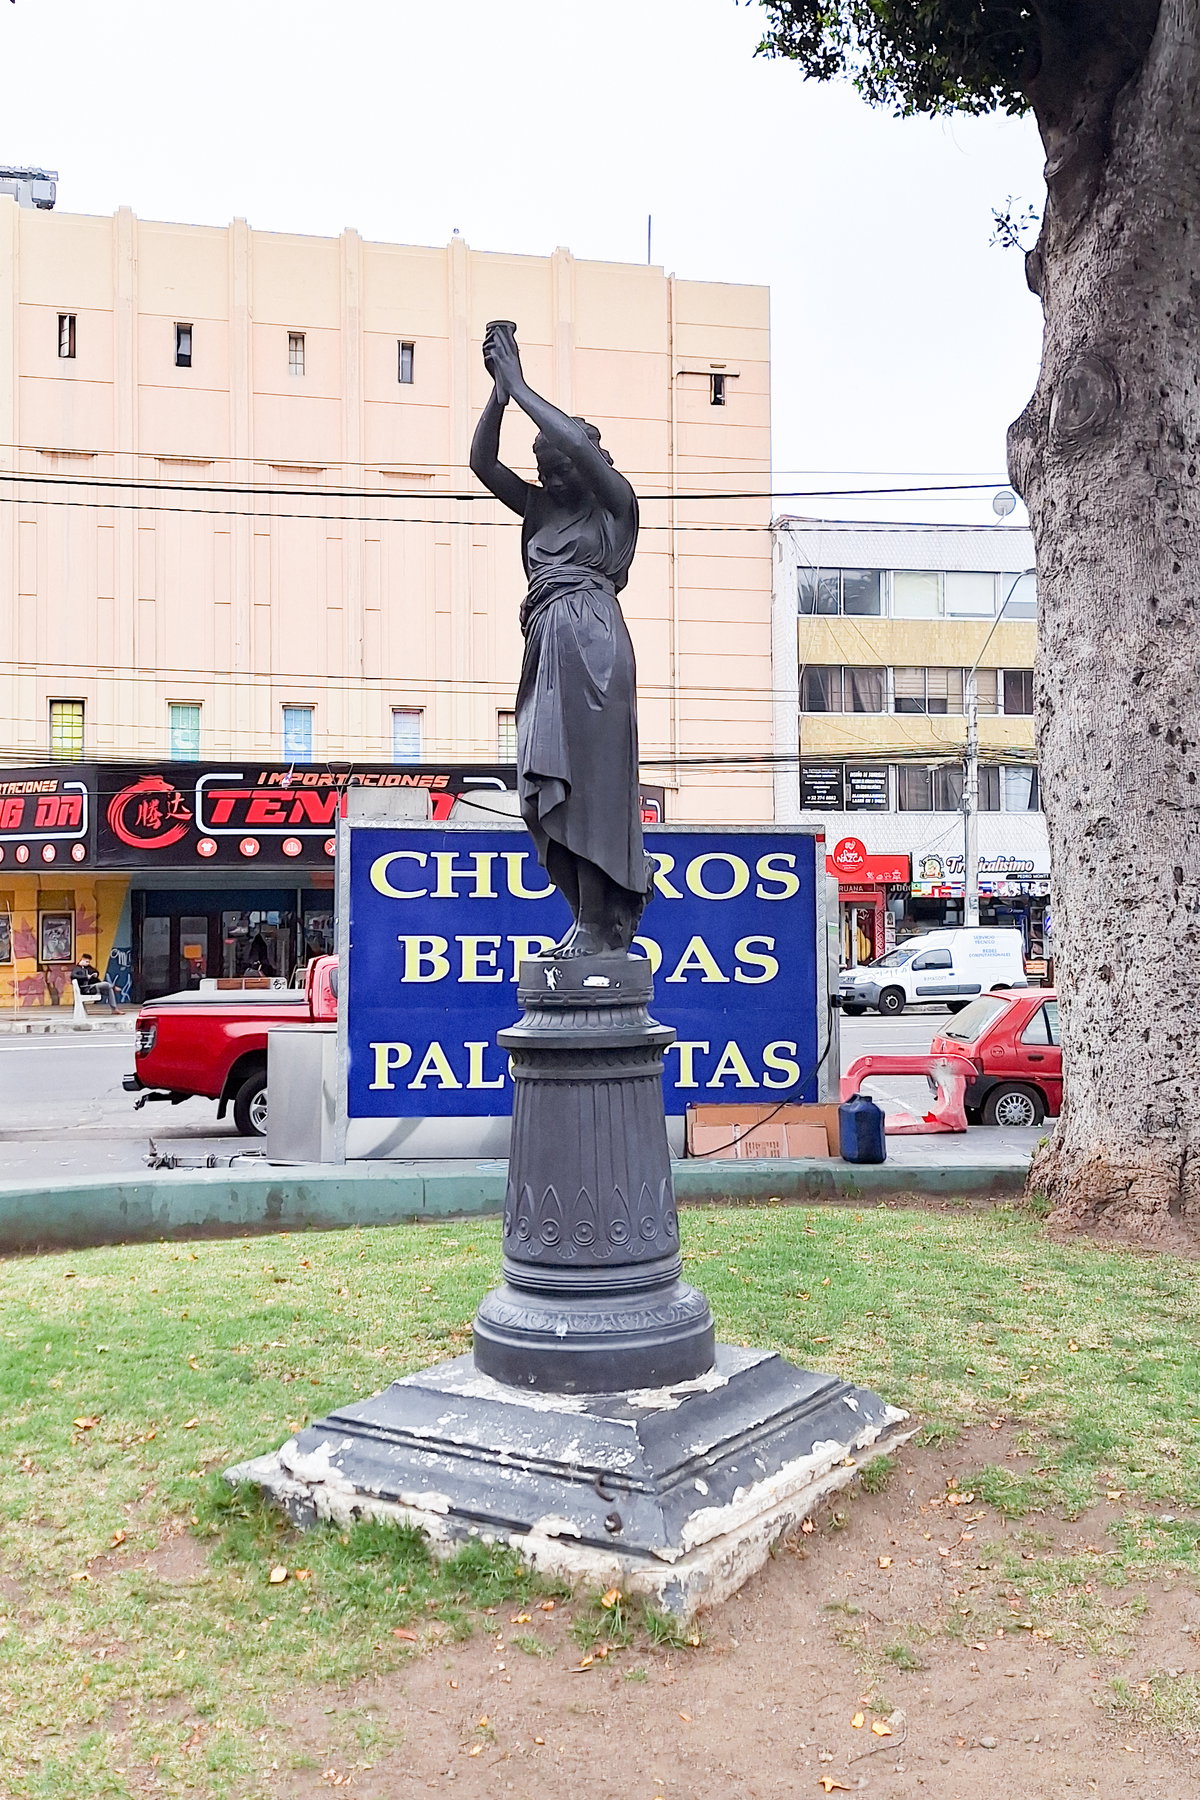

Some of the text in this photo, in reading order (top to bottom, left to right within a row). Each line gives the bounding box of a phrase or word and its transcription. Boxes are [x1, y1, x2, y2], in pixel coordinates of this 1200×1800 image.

[0, 780, 58, 795] TACIONES
[257, 772, 450, 788] IMPORTACIONES
[35, 795, 83, 827] DA
[208, 790, 347, 824] TEN
[837, 855, 864, 863] NAZCA
[946, 855, 1034, 875] Tricalisimo
[370, 851, 799, 899] CHUROS
[369, 1040, 799, 1090] PALTAS
